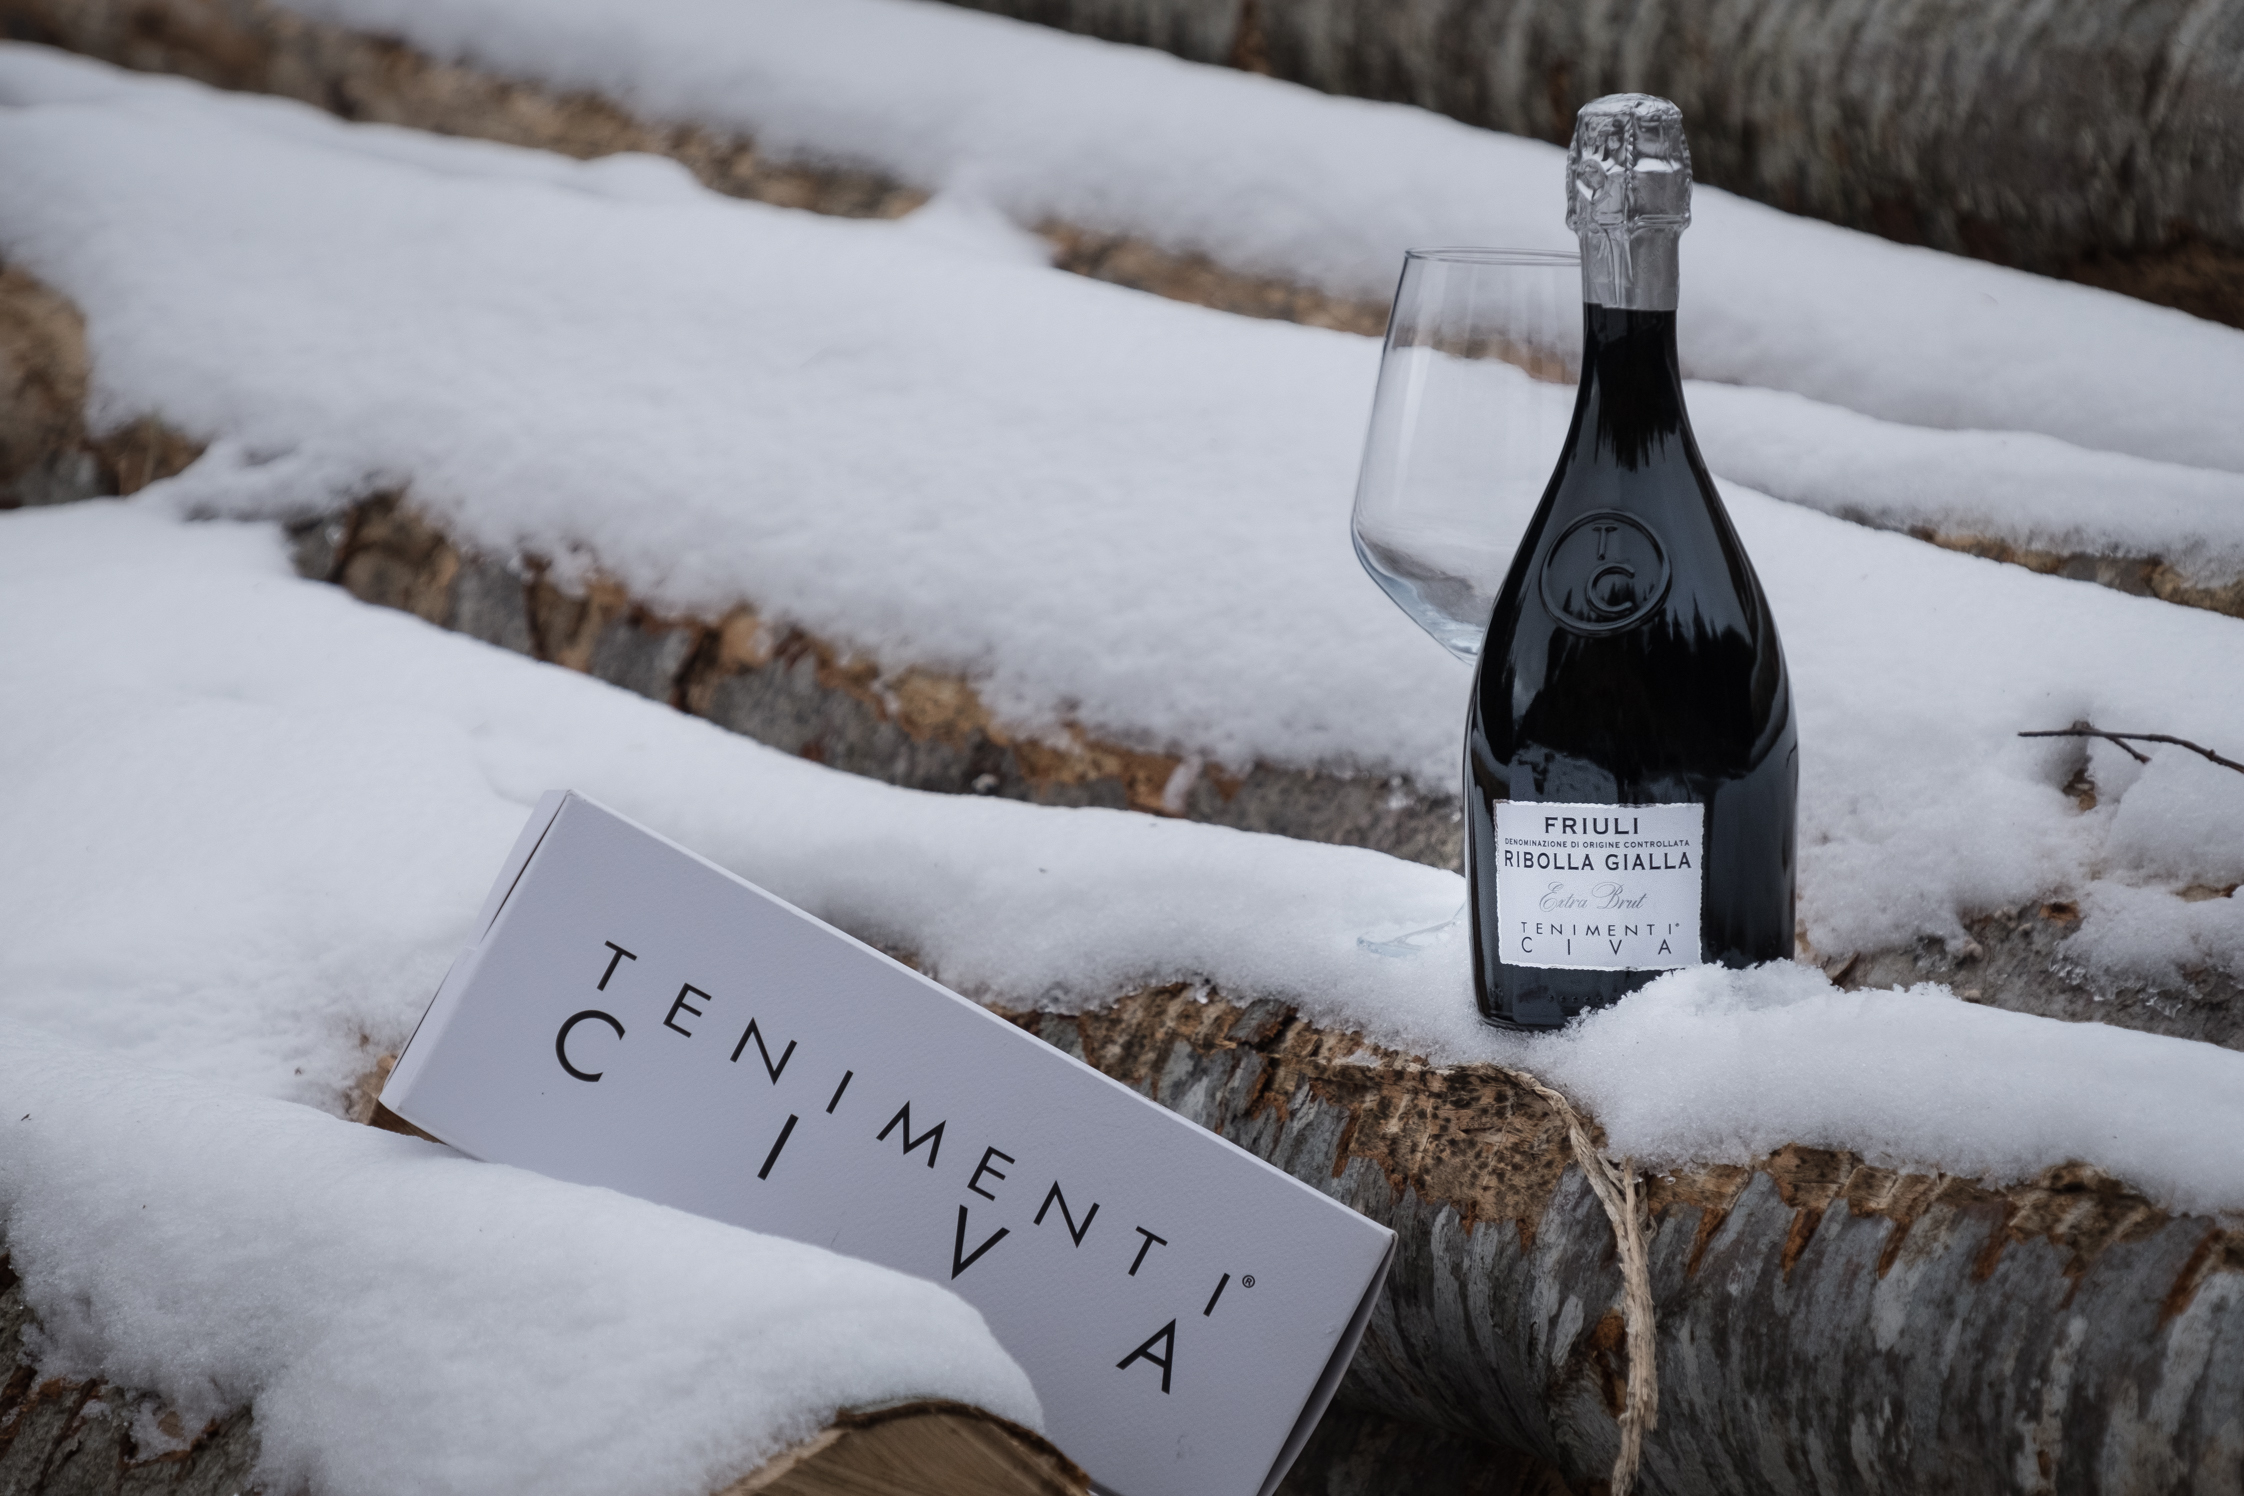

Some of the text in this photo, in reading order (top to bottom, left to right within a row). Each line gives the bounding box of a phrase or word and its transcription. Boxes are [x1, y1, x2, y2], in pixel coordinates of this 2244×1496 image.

[1544, 816, 1640, 835] FRIULI
[1504, 837, 1690, 849] DENOMINAZIONE DI ORIGINE CONTROLLATA
[1504, 850, 1692, 870] RIBOLLA GIALLA
[1538, 881, 1648, 913] Extra Brut
